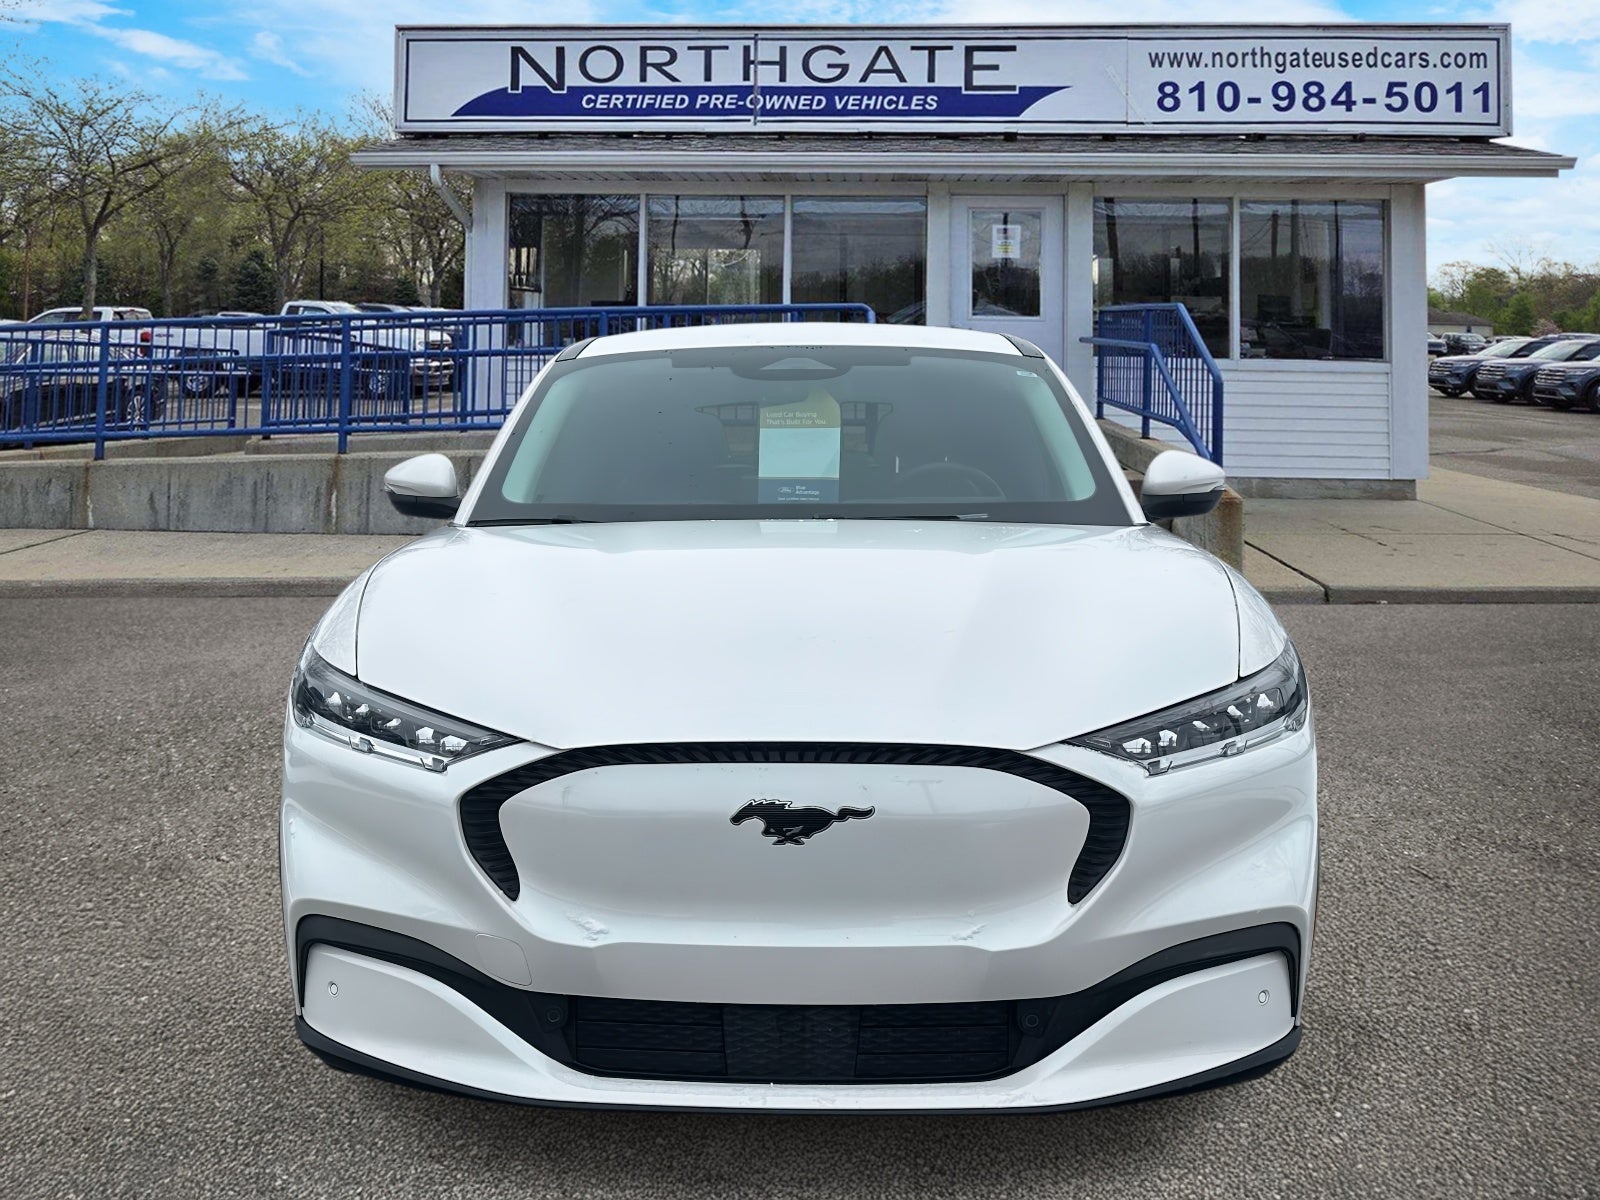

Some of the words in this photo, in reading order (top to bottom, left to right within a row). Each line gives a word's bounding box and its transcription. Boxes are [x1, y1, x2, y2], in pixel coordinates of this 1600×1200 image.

[509, 45, 1018, 94] NORTHGATE
[1148, 46, 1489, 74] www.northgateusedcars.com
[581, 93, 689, 110] CERTIFIED
[694, 93, 827, 111] PRE-OWNED
[833, 94, 939, 112] VEHICLES
[1156, 80, 1491, 114] 810-984-5011
